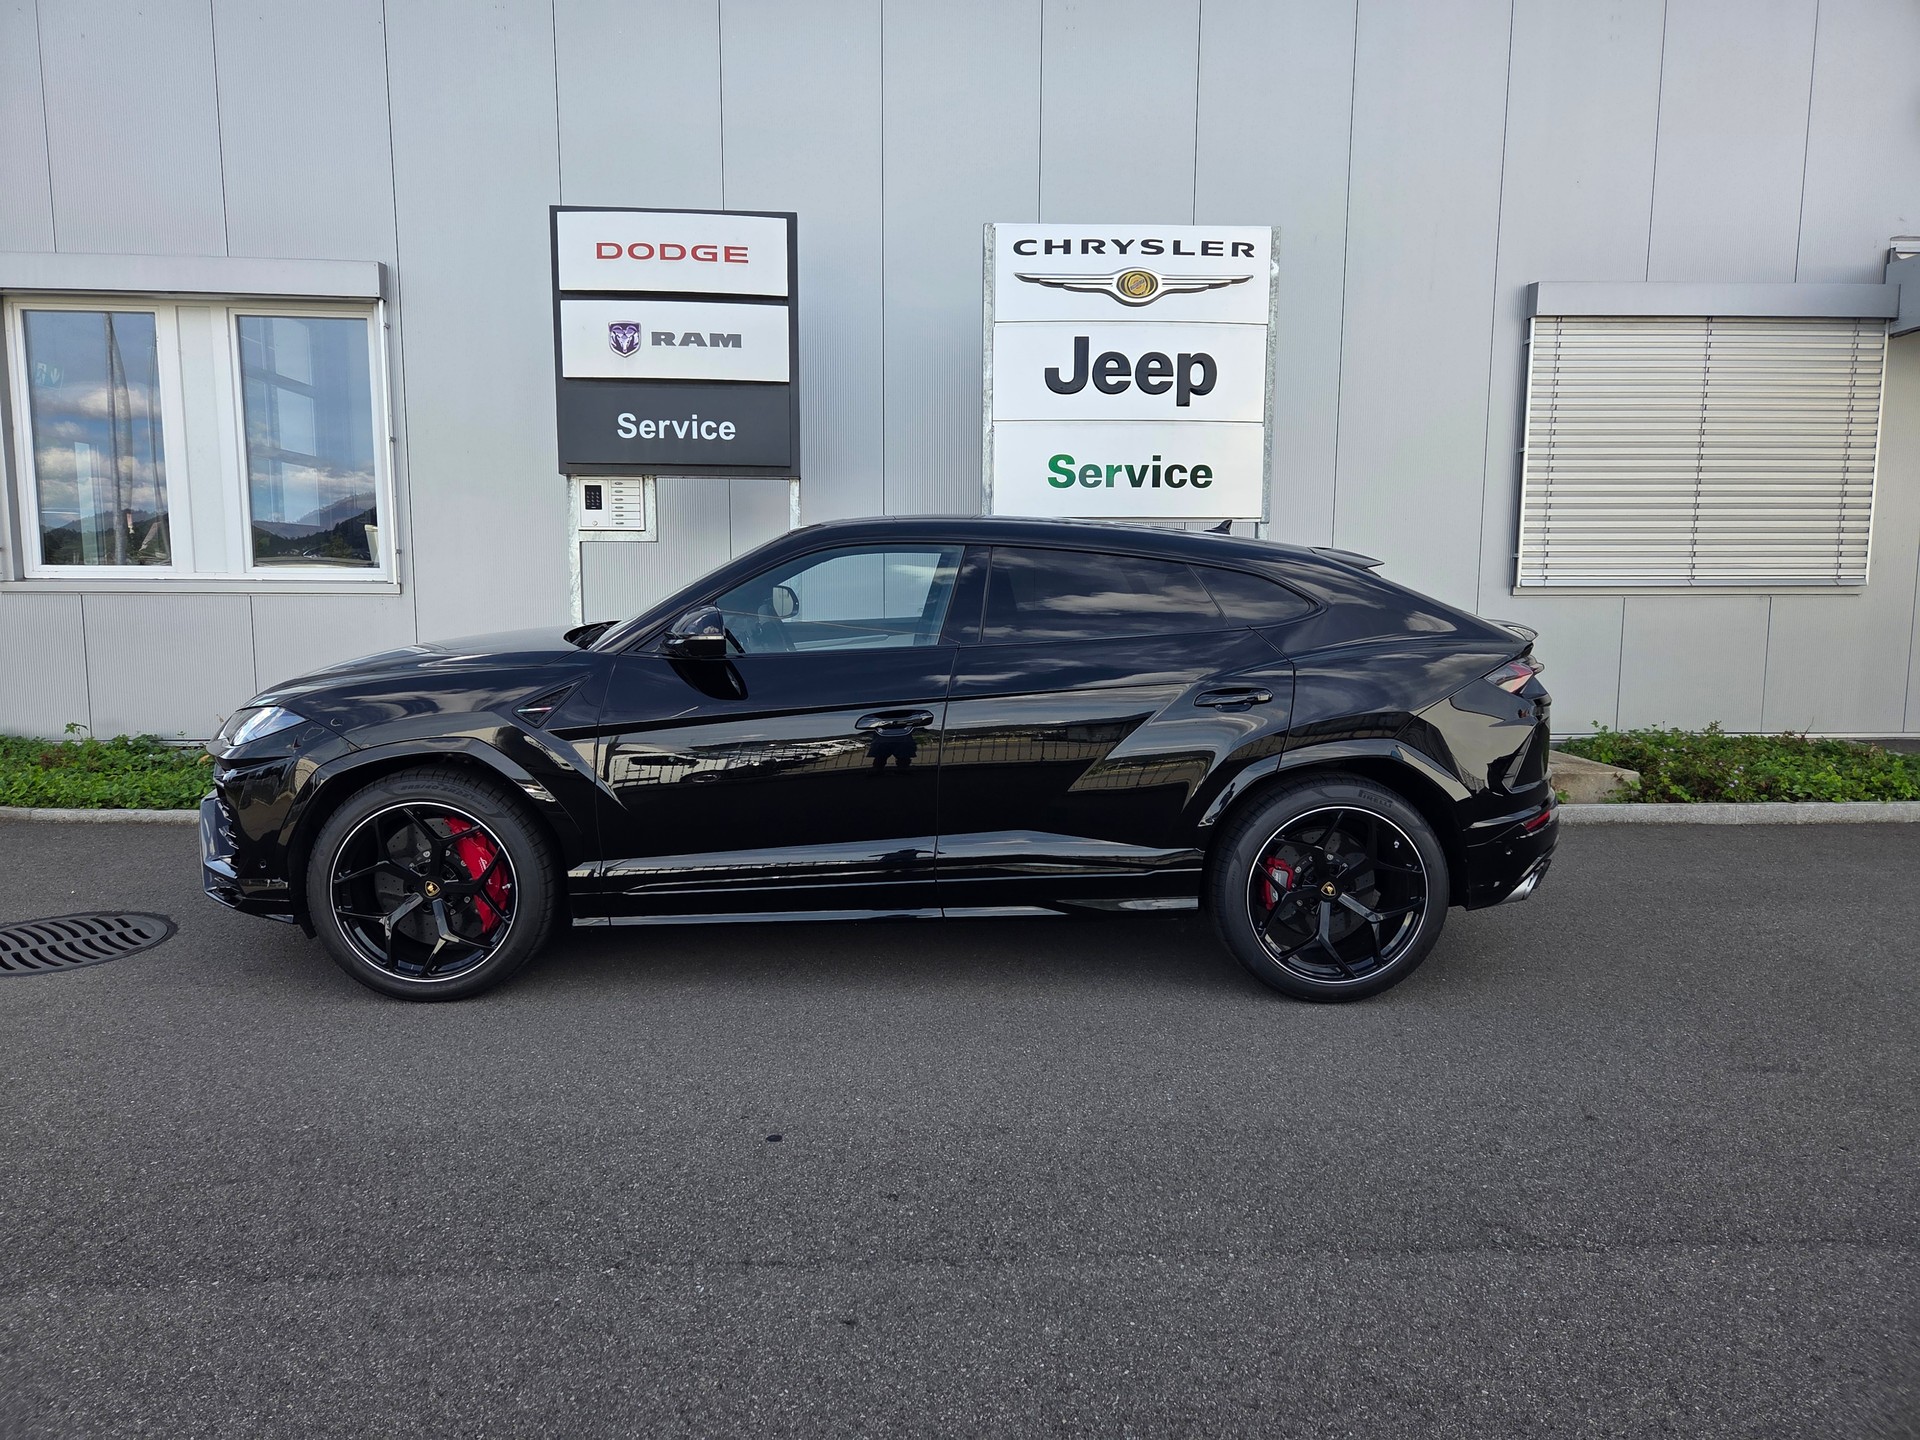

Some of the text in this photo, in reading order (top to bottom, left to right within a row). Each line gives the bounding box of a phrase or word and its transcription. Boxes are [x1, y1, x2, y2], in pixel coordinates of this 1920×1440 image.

[596, 242, 749, 264] DODGE
[1013, 239, 1256, 258] CHRYSLER
[651, 331, 742, 349] RAM
[1044, 336, 1218, 407] Jeep
[617, 412, 737, 441] Service
[1047, 453, 1214, 489] Service
